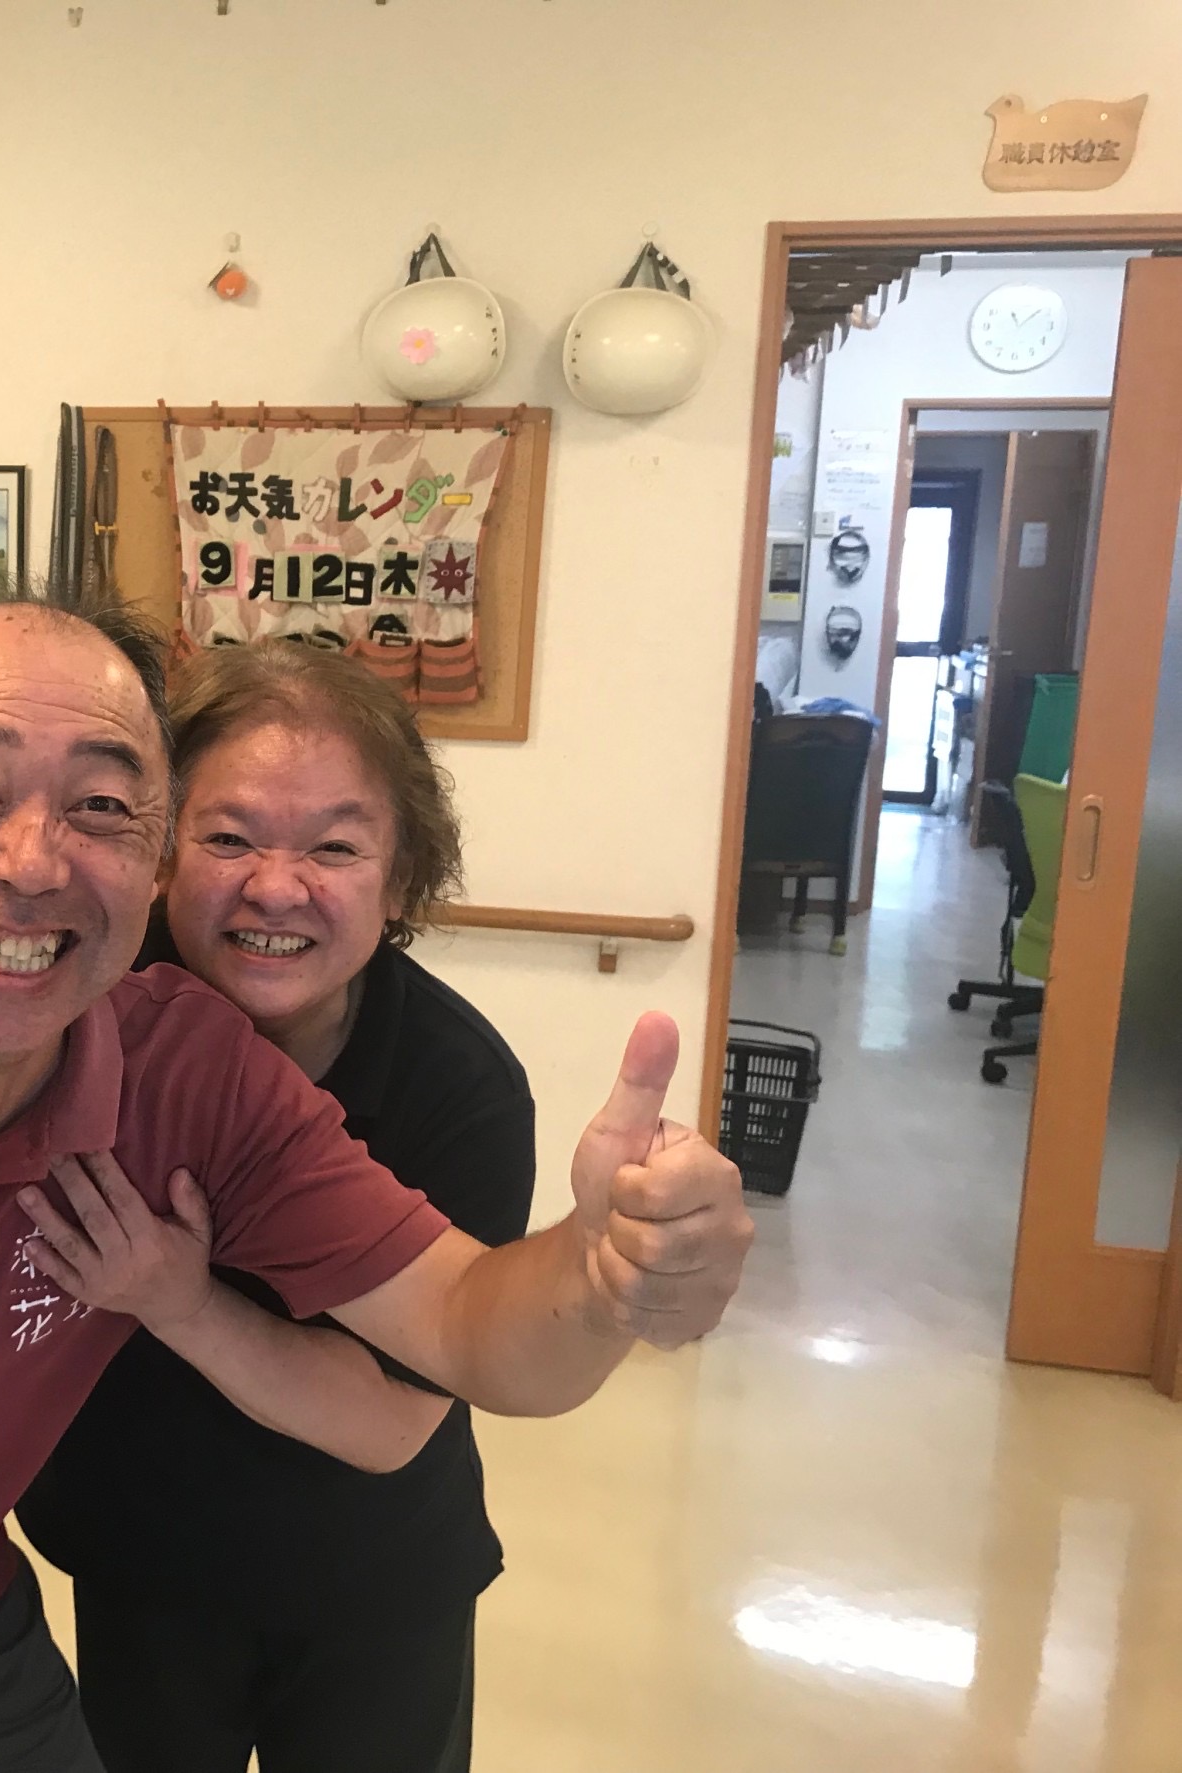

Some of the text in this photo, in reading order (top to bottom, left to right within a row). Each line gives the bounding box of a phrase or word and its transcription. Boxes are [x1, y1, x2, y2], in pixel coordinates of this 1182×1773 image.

[189, 471, 473, 523] お天気カレンダー
